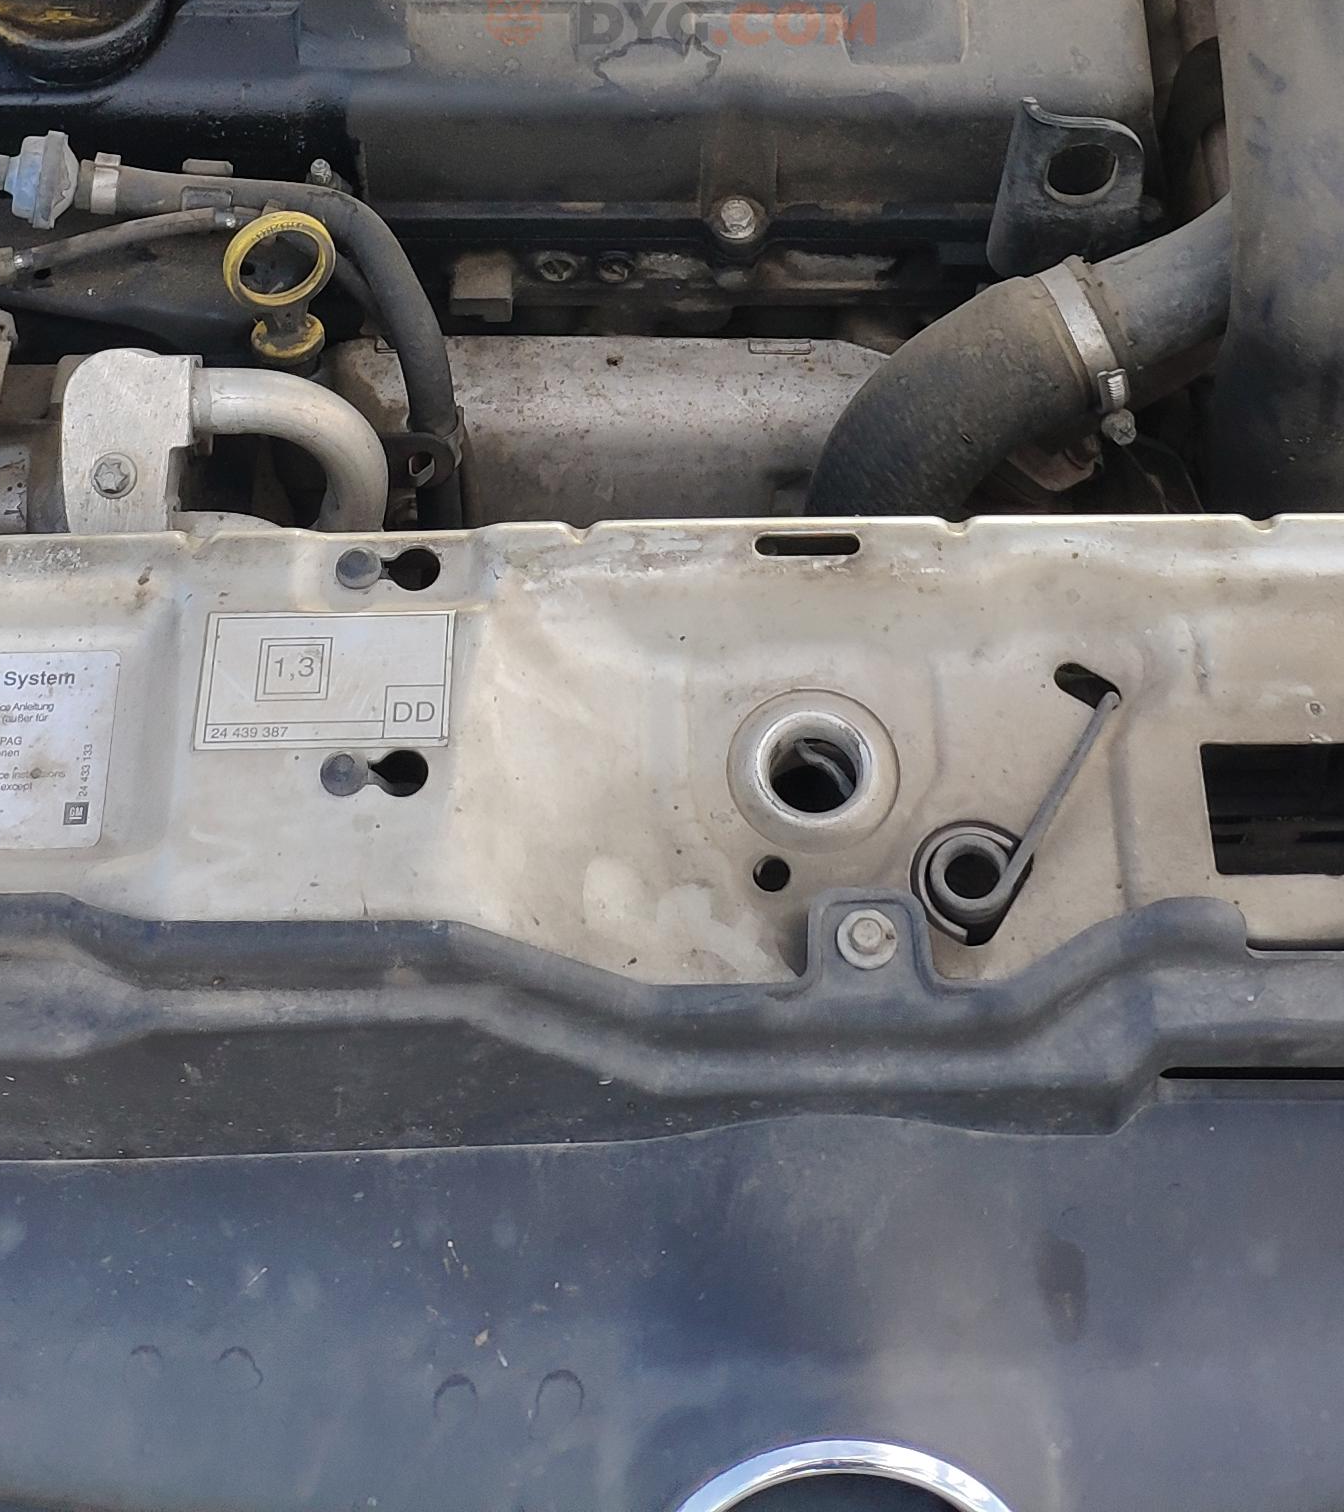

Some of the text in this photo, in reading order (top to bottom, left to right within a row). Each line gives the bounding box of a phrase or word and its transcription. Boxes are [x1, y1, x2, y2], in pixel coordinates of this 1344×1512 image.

[273, 656, 316, 681] 1,3
[3, 671, 76, 691] System
[391, 701, 435, 723] DD
[0, 737, 23, 747] PAG
[211, 726, 289, 739] 24 439 387
